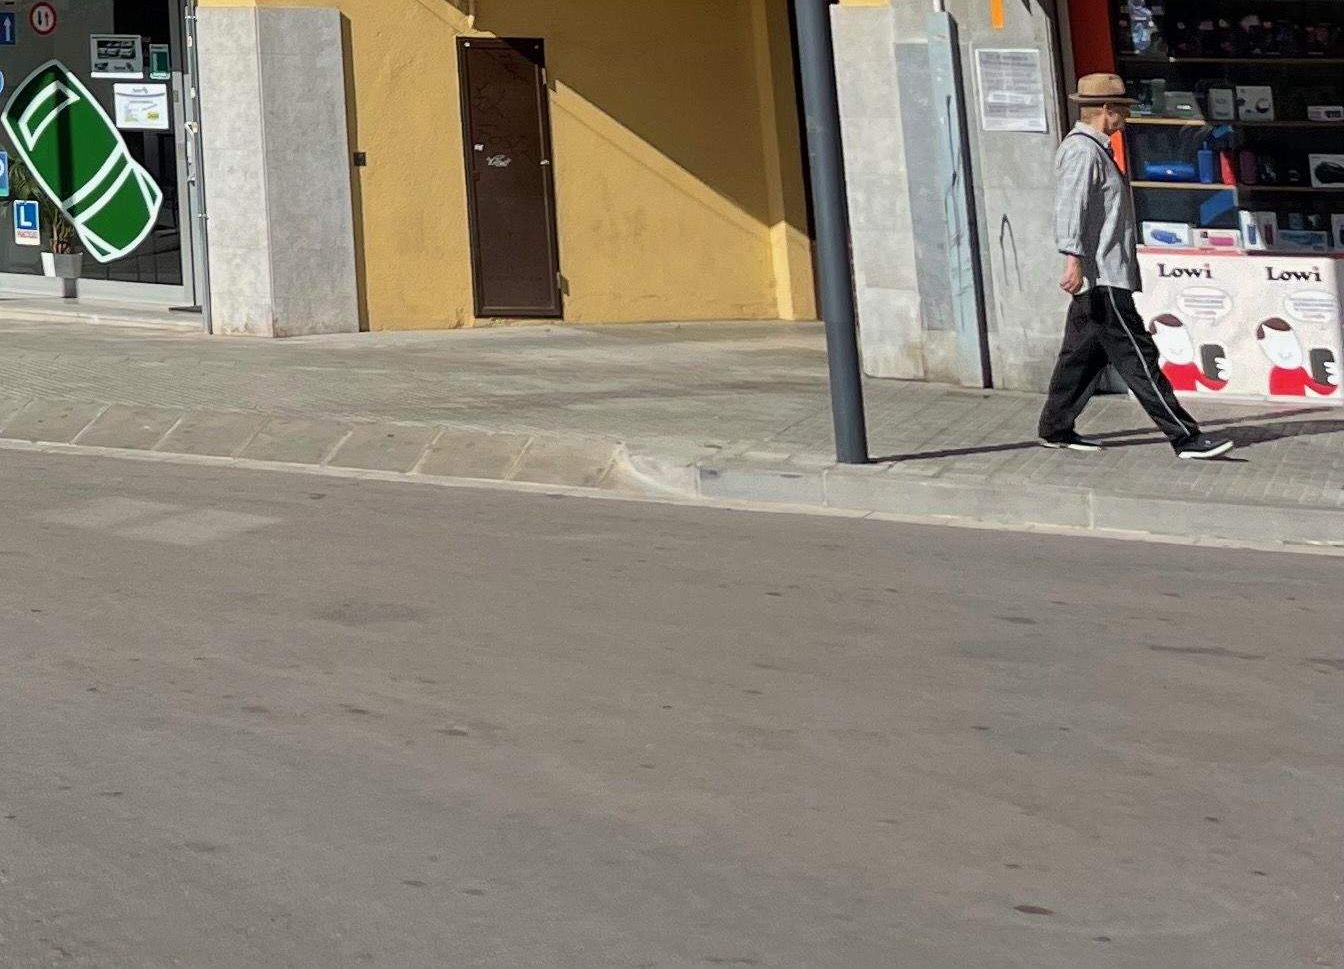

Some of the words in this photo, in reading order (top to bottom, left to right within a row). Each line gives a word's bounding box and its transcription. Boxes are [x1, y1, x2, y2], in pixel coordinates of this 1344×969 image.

[19, 205, 33, 227] L
[1157, 262, 1213, 279] Lowi
[1265, 265, 1323, 282] Lowi
